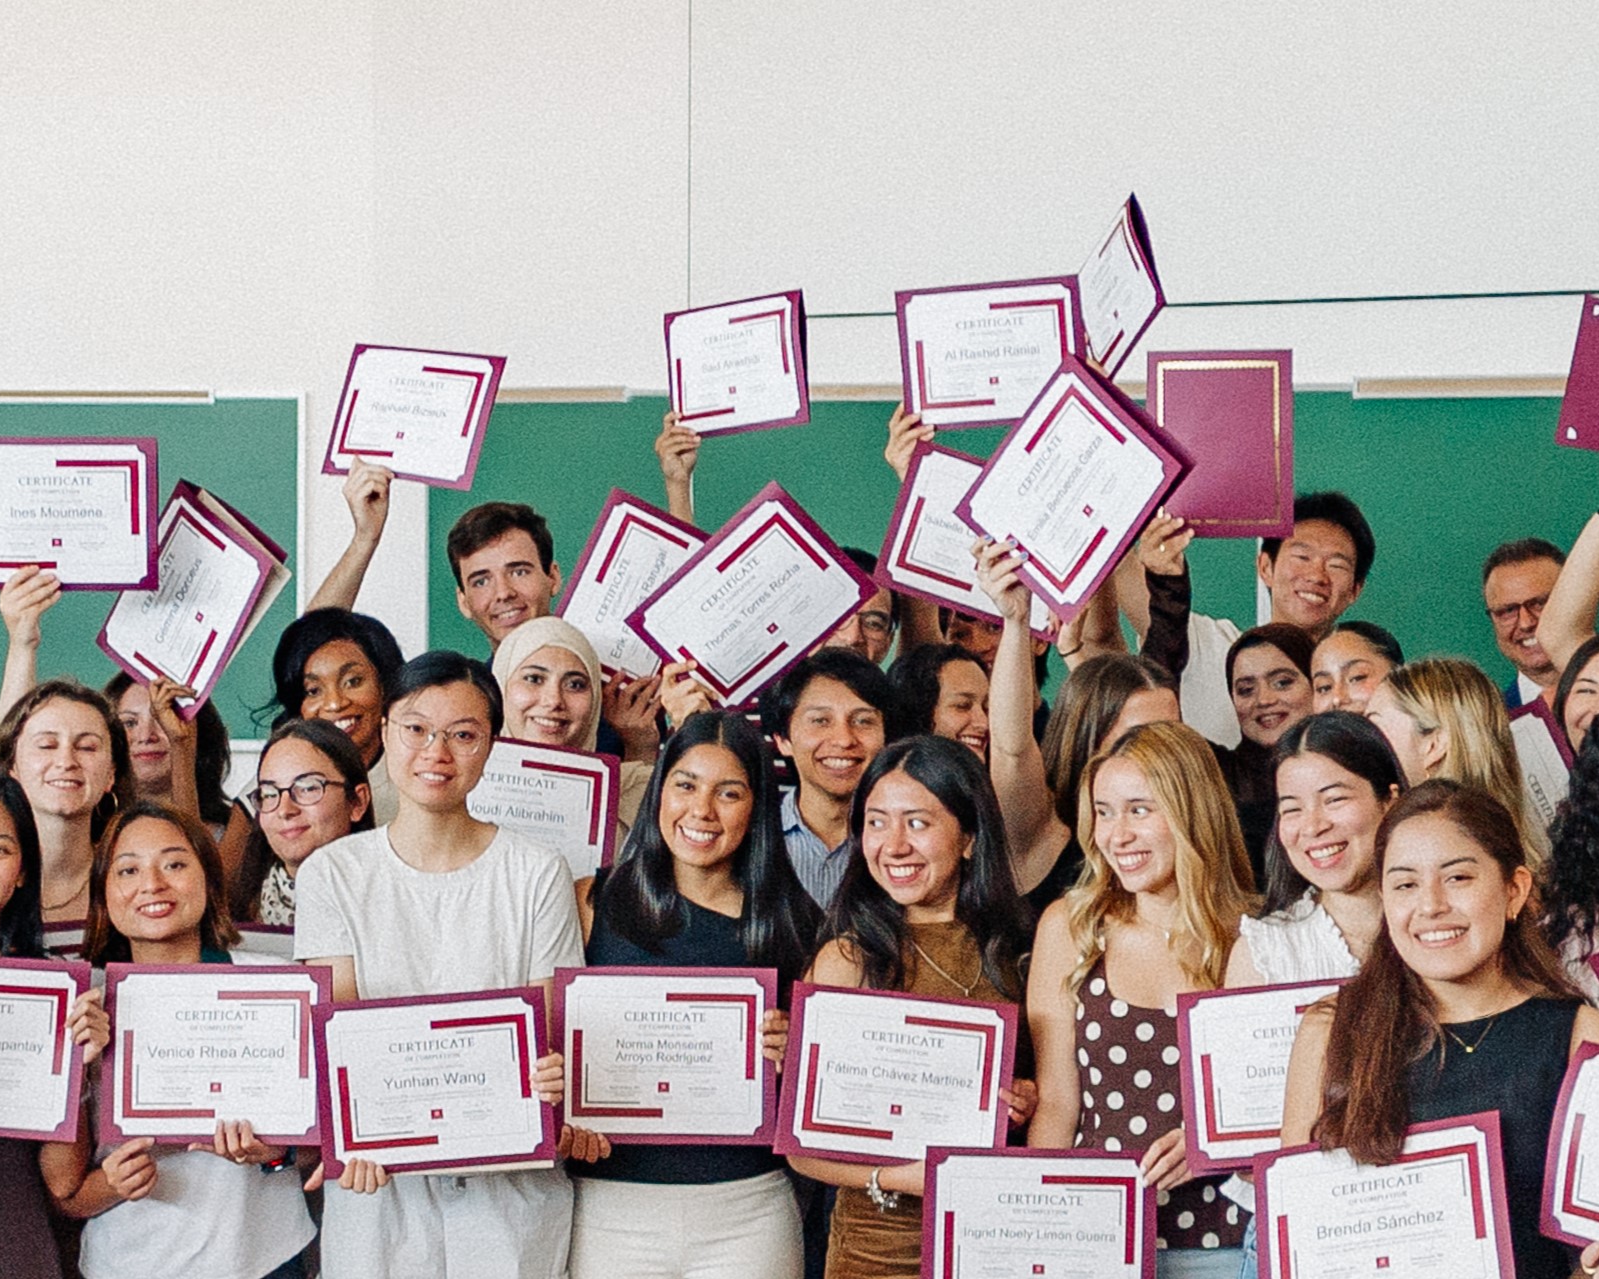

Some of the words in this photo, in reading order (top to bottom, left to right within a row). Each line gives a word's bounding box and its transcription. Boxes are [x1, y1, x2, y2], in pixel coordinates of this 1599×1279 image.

[955, 316, 1025, 330] CERTIFICATE
[1078, 435, 1103, 465] Garza
[1018, 435, 1063, 497] CERTIFICATE
[18, 476, 93, 487] CERTIFICATE
[10, 507, 37, 519] Ines
[595, 557, 630, 624] CERTIFICATE
[700, 556, 761, 612] CERTIFICATE
[705, 619, 742, 652] Thomas
[741, 591, 771, 617] Torres
[769, 563, 800, 592] Rocha
[505, 805, 565, 823] Alibrahim
[175, 1010, 258, 1021] CERTIFICATE
[624, 1011, 707, 1023] CERTIFICATE
[862, 1030, 945, 1049] CERTIFICATE
[1253, 1025, 1299, 1040] CERTIF
[147, 1045, 195, 1059] Venice
[199, 1046, 237, 1059] Rhea
[241, 1046, 285, 1059] Accad
[389, 1037, 475, 1054] CERTIFICATE
[616, 1039, 654, 1050] Norma
[657, 1039, 713, 1050] Monserrat
[615, 1051, 653, 1065] Arroyo
[826, 1059, 869, 1078] Fátima
[872, 1065, 918, 1083] Chávez
[1246, 1064, 1286, 1079] Dana
[384, 1074, 439, 1091] Yunhan
[443, 1071, 486, 1086] Wang
[1331, 1173, 1424, 1198] CERTIFICATE
[998, 1194, 1084, 1206] CERTIFICATE
[1317, 1221, 1372, 1240] Brenda
[1377, 1209, 1445, 1232] Sánchez
[964, 1227, 996, 1241] Ingrid
[999, 1228, 1033, 1242] Noely
[1037, 1229, 1072, 1241] Limón
[1076, 1231, 1116, 1242] Guerra
